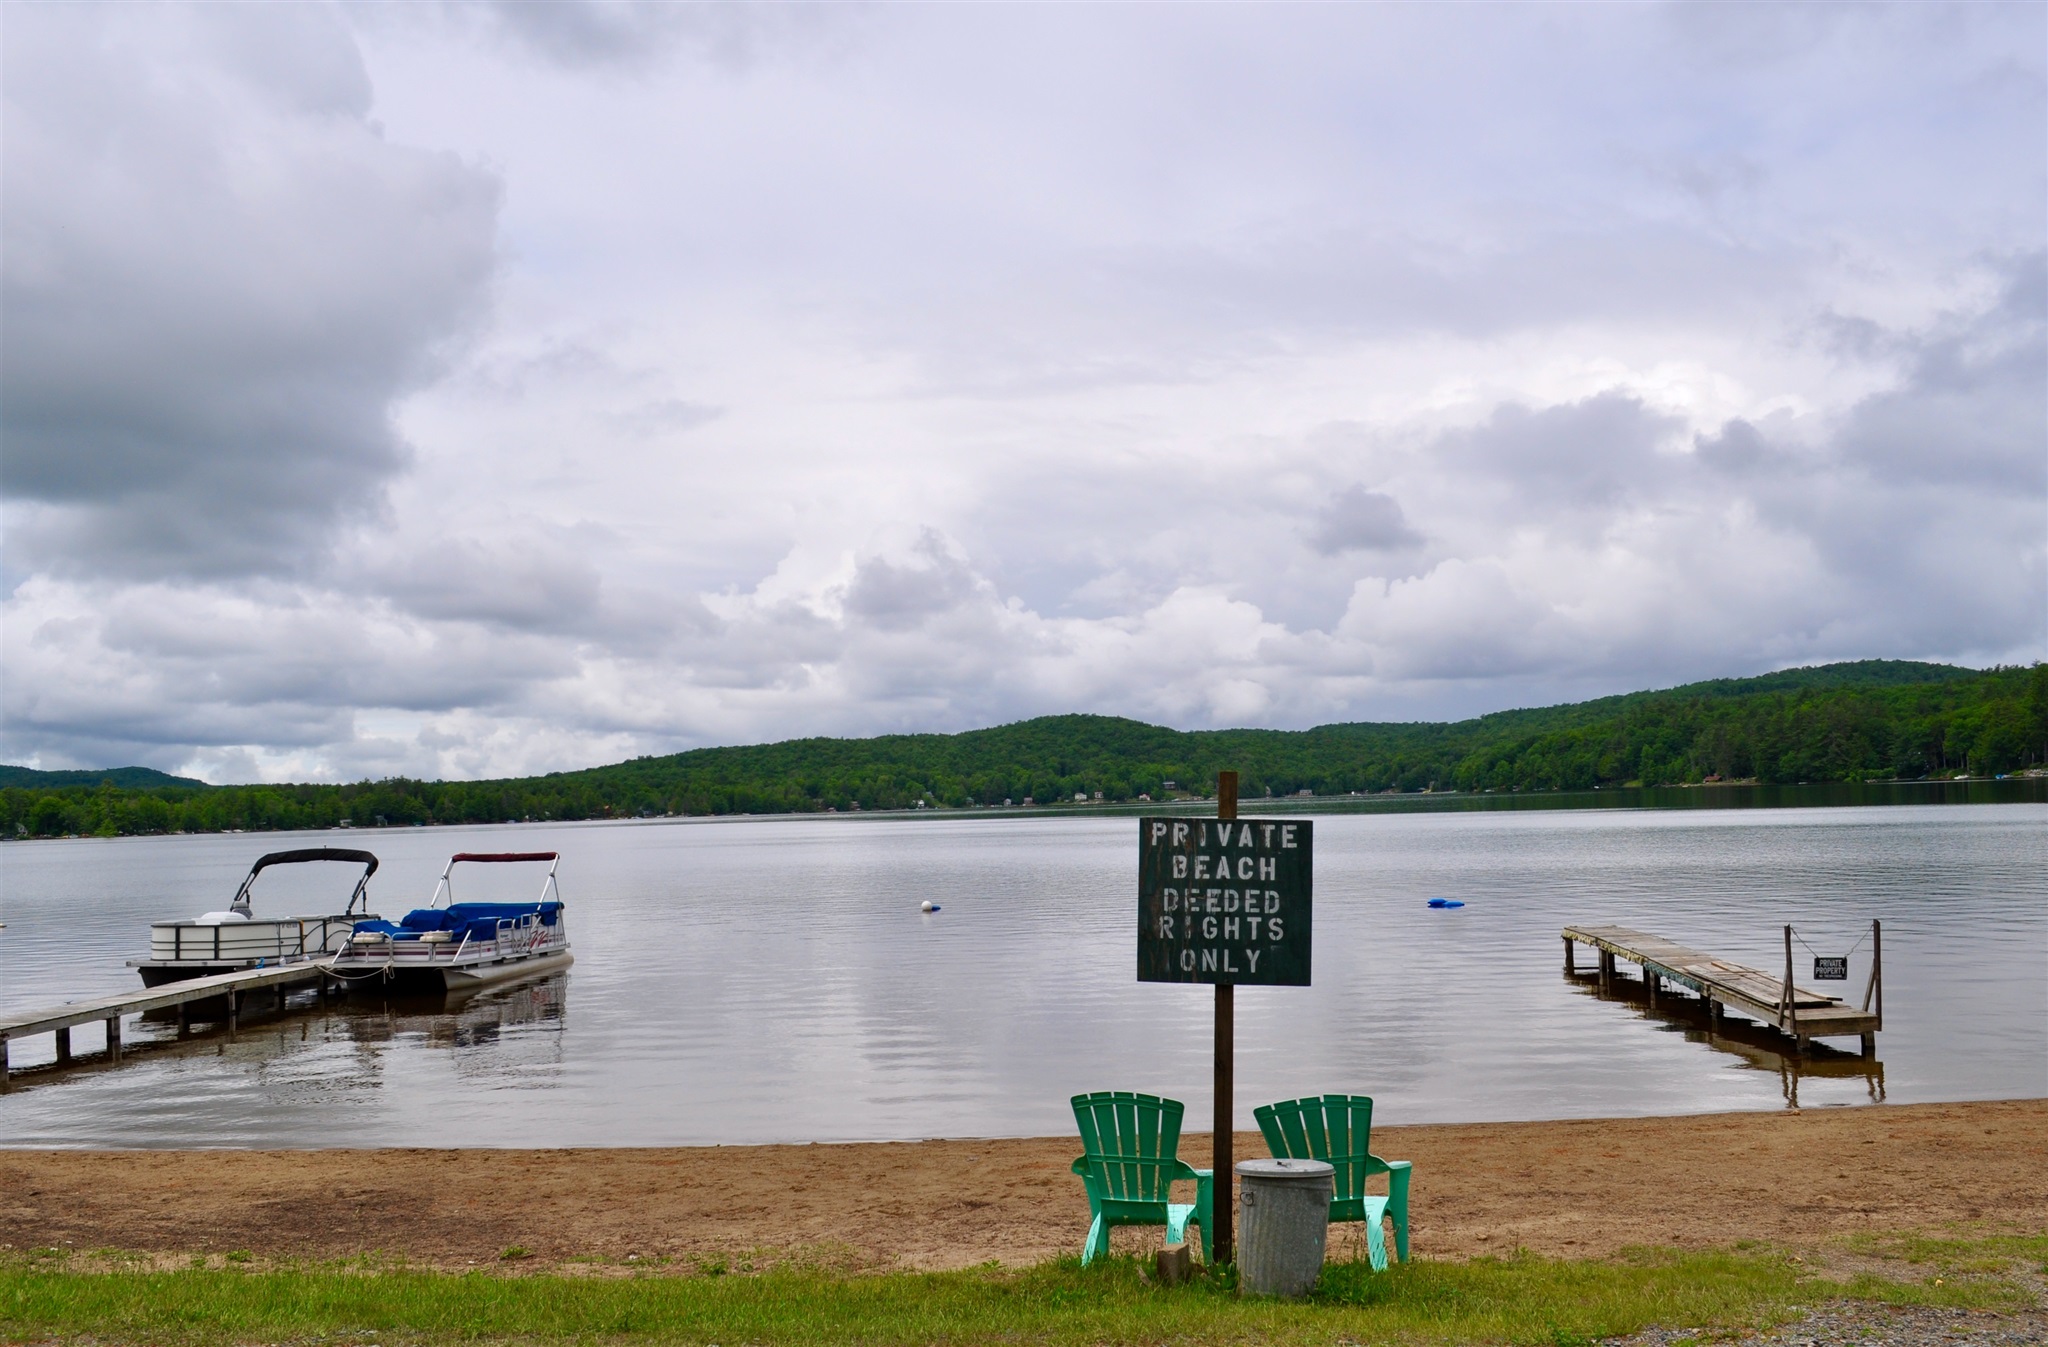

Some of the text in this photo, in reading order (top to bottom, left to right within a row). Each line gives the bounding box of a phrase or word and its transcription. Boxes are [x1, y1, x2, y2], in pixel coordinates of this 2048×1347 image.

[1151, 822, 1298, 849] PRIVATE
[1172, 855, 1276, 881] BEACH
[1163, 887, 1280, 914] DEEDED
[1158, 915, 1284, 941] RIGHTS
[1180, 948, 1261, 974] ONLY
[1819, 959, 1842, 967] PRIVATE
